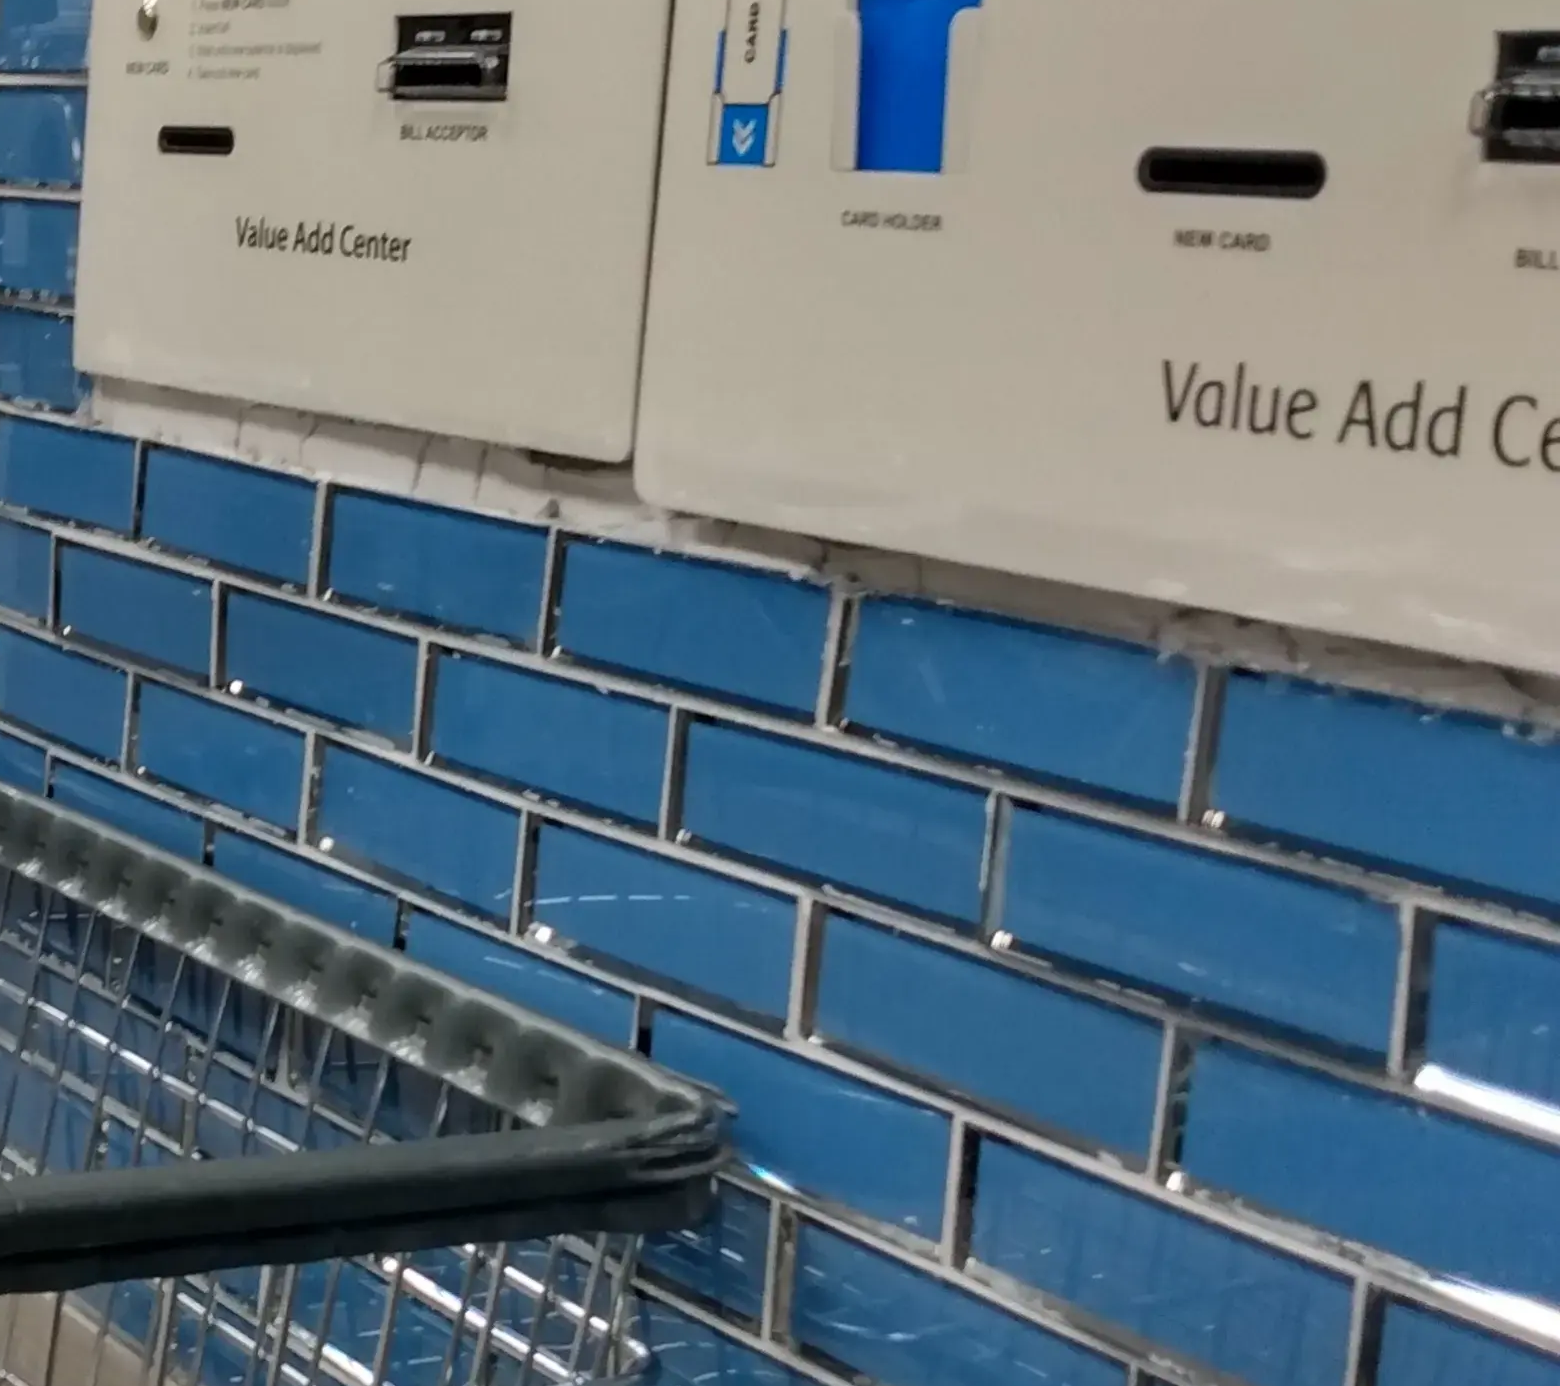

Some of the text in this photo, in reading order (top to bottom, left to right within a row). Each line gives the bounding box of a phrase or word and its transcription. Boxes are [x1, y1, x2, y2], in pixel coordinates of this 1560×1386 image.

[744, 2, 761, 64] CARD
[425, 124, 489, 143] ACCEPTOR
[235, 215, 412, 264] Value Add Center
[882, 214, 943, 232] HOLDER
[1173, 228, 1271, 253] NEW CARD
[1160, 358, 1319, 441] Value
[1335, 378, 1469, 459] Add
